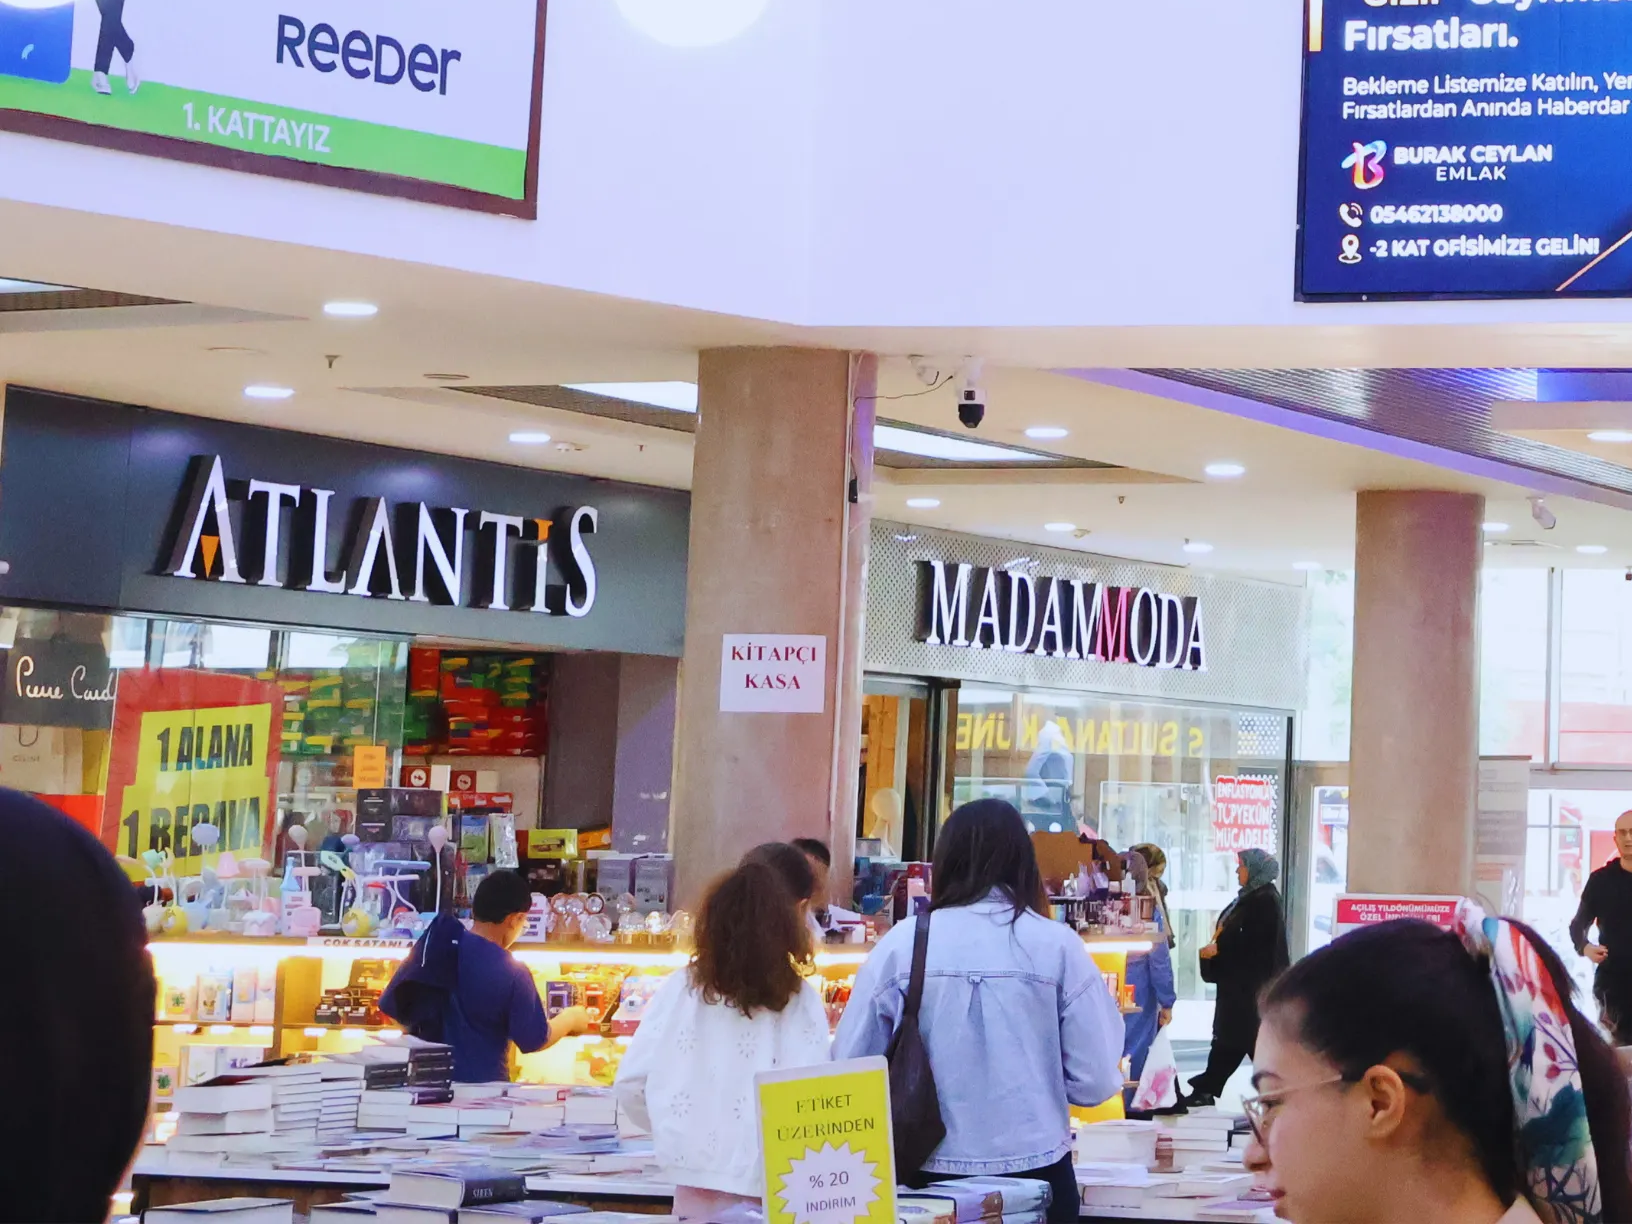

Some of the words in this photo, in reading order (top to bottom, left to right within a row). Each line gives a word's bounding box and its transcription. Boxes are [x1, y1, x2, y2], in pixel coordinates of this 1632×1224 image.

[1344, 16, 1519, 52] Fırsatları.
[1343, 75, 1429, 96] Bekleme
[1434, 73, 1526, 95] Listemize
[1531, 72, 1599, 95] Katılın,
[1342, 99, 1457, 120] Fırsatlardan
[1461, 98, 1532, 117] Anında
[1537, 96, 1630, 116] Haberdar
[182, 102, 201, 131] 1.
[207, 105, 332, 154] KATTAYIZ
[1393, 146, 1467, 165] BURAK
[1470, 144, 1553, 164] CEYLAN
[1435, 165, 1507, 182] EMLAK
[1370, 204, 1503, 224] 05462138000
[1369, 239, 1389, 258] -2
[1391, 239, 1430, 257] KAT
[1433, 234, 1532, 257] OFİSİMİZE
[1535, 233, 1600, 256] GELİN!
[731, 642, 816, 665] KİTAPÇI
[744, 673, 801, 690] KASA
[157, 727, 171, 772] 1
[176, 723, 254, 772] ALANA
[123, 809, 140, 859] 1
[1360, 912, 1383, 922] ÖZEL
[796, 1094, 852, 1114] ETİKET
[777, 1116, 875, 1142] ÜZERİNDEN
[809, 1174, 824, 1189] %
[829, 1171, 849, 1187] 20
[806, 1195, 856, 1214] İNDİRİM
